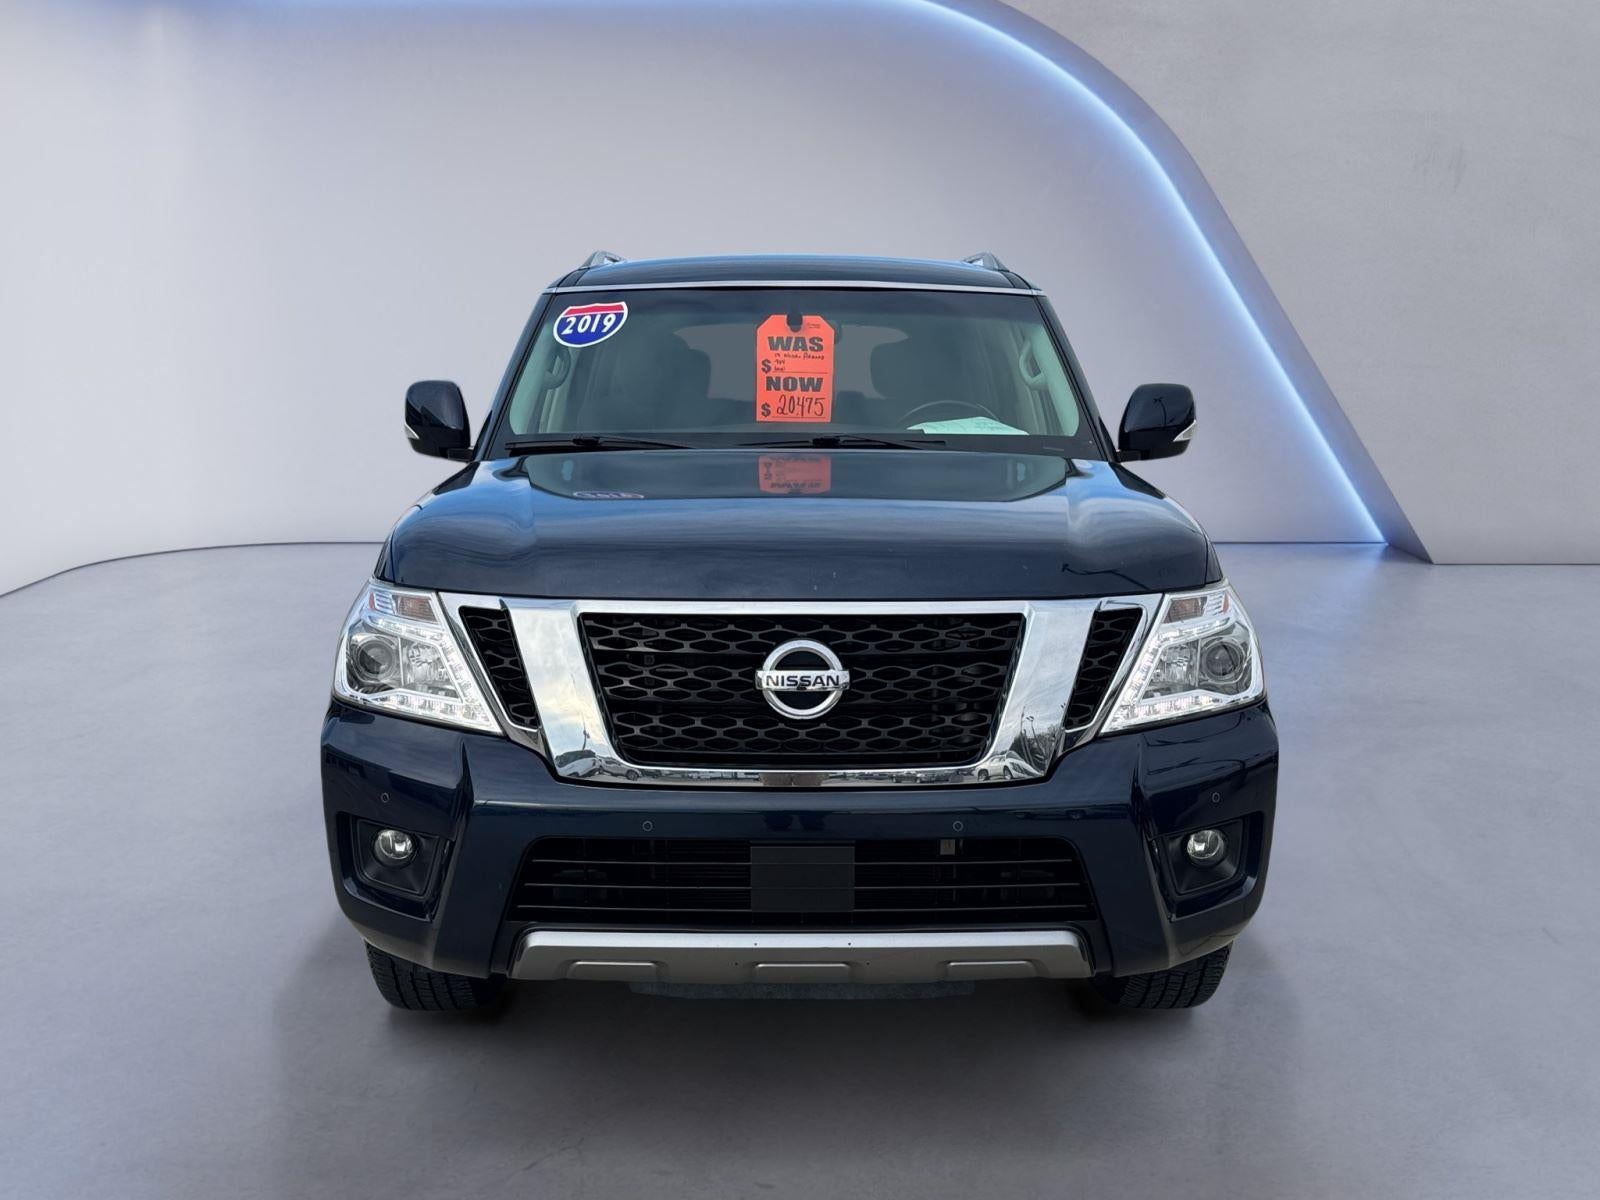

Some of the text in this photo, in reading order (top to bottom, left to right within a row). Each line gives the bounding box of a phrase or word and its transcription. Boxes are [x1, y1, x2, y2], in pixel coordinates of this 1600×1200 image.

[561, 313, 616, 335] 2019
[767, 336, 824, 352] WAS
[761, 359, 772, 374] $
[766, 376, 824, 392] NOW
[761, 402, 771, 417] $
[766, 675, 839, 687] NISSAN
